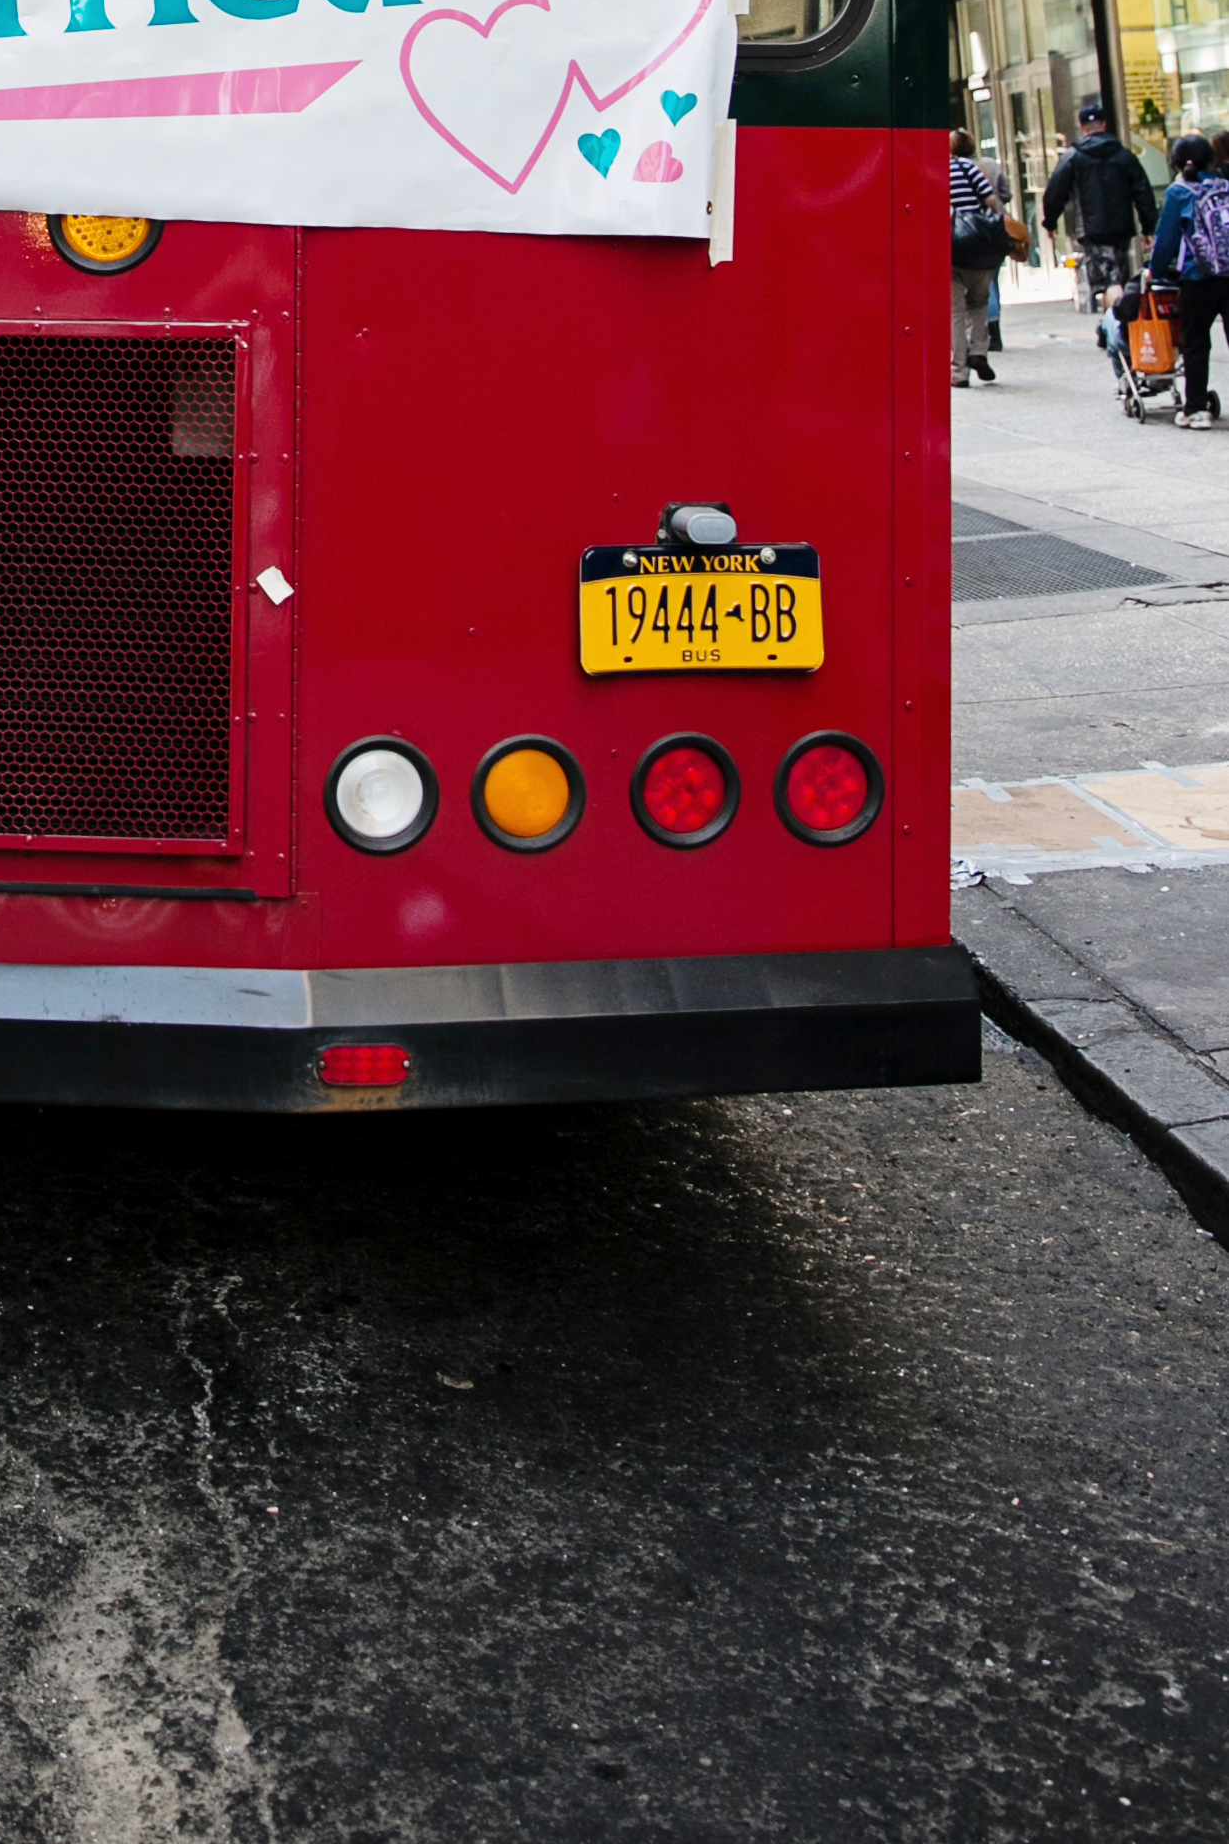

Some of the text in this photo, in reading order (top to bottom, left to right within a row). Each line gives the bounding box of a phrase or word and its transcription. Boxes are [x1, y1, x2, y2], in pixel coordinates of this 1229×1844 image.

[639, 554, 761, 574] NEW YORK
[605, 580, 798, 646] 19444 BB
[681, 649, 721, 663] BUS
